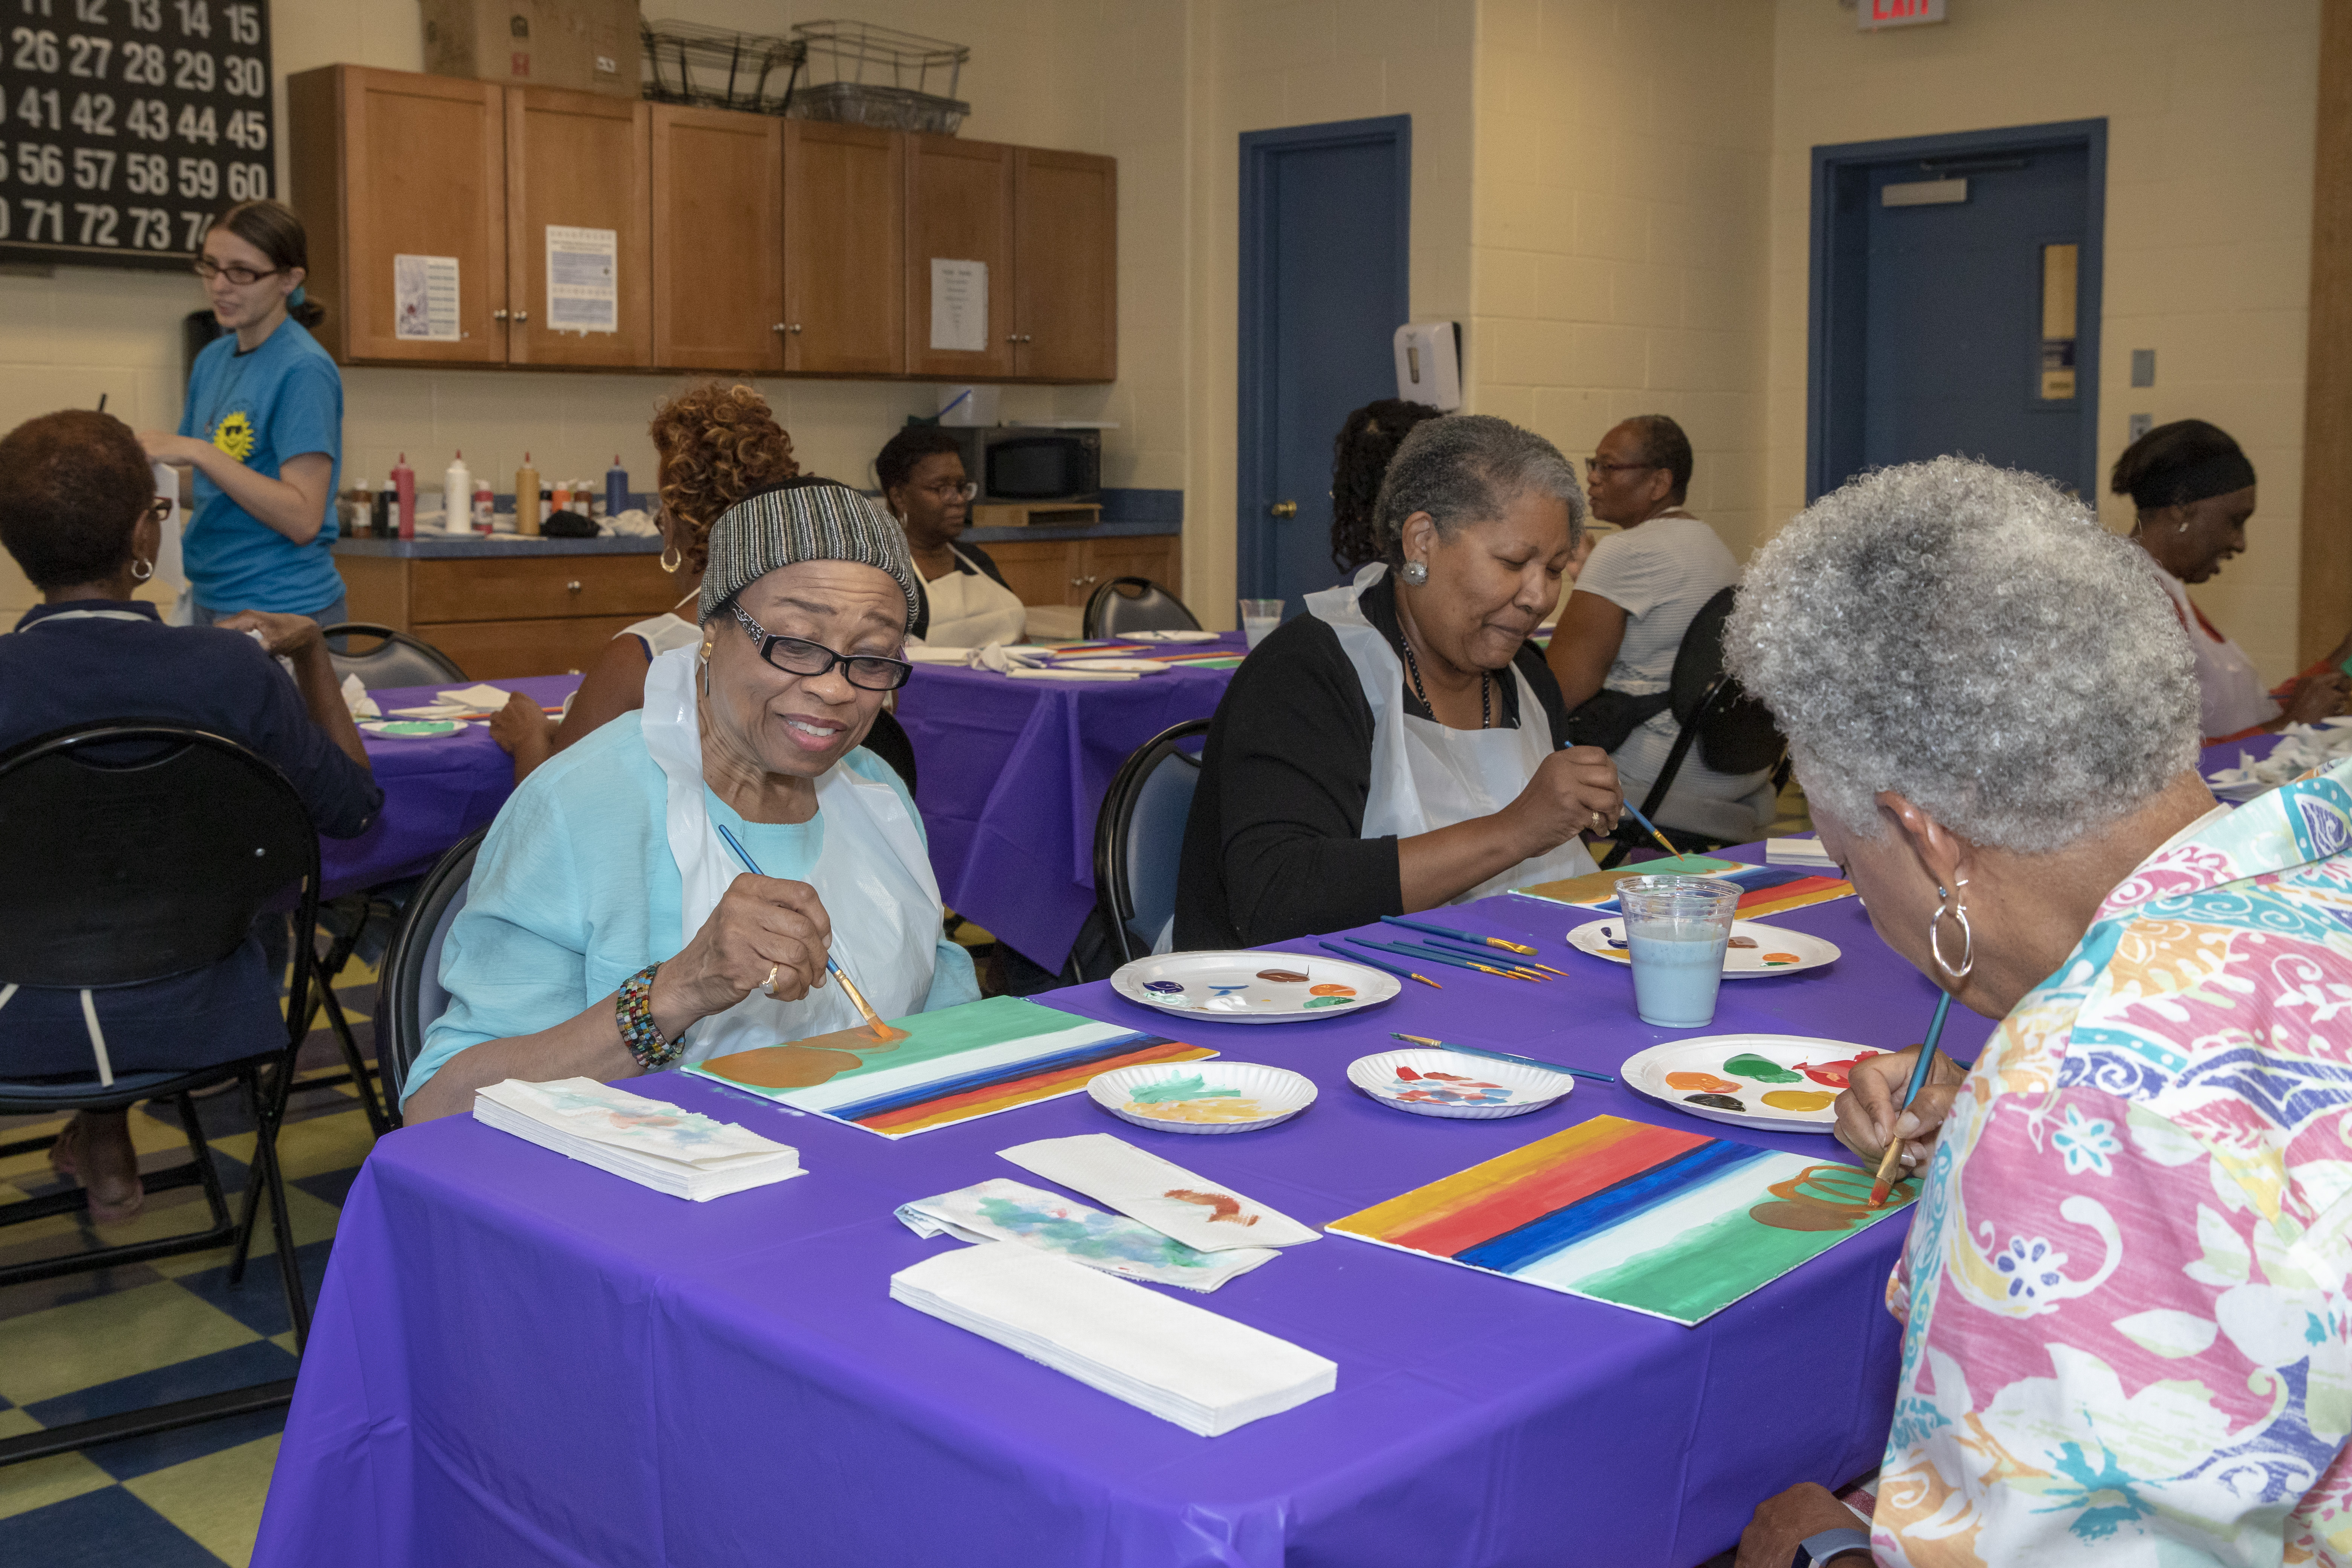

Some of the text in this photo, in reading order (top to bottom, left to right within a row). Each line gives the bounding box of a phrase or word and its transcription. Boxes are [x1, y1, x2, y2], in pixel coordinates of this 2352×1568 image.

[128, 0, 161, 30] 13
[176, 0, 210, 37] 14
[225, 6, 259, 44] 15
[13, 28, 263, 97] 26 27 28 29 30
[19, 88, 60, 129] 41
[72, 94, 115, 135] 42
[127, 100, 169, 140] 43
[178, 106, 217, 144] 44
[227, 111, 266, 149] 45
[19, 143, 63, 185] 56
[75, 149, 115, 189] 57
[128, 154, 168, 194] 58
[179, 158, 218, 198] 59
[229, 163, 267, 201] 60
[23, 200, 62, 241] 71
[76, 204, 117, 245] 72
[129, 208, 170, 249] 73
